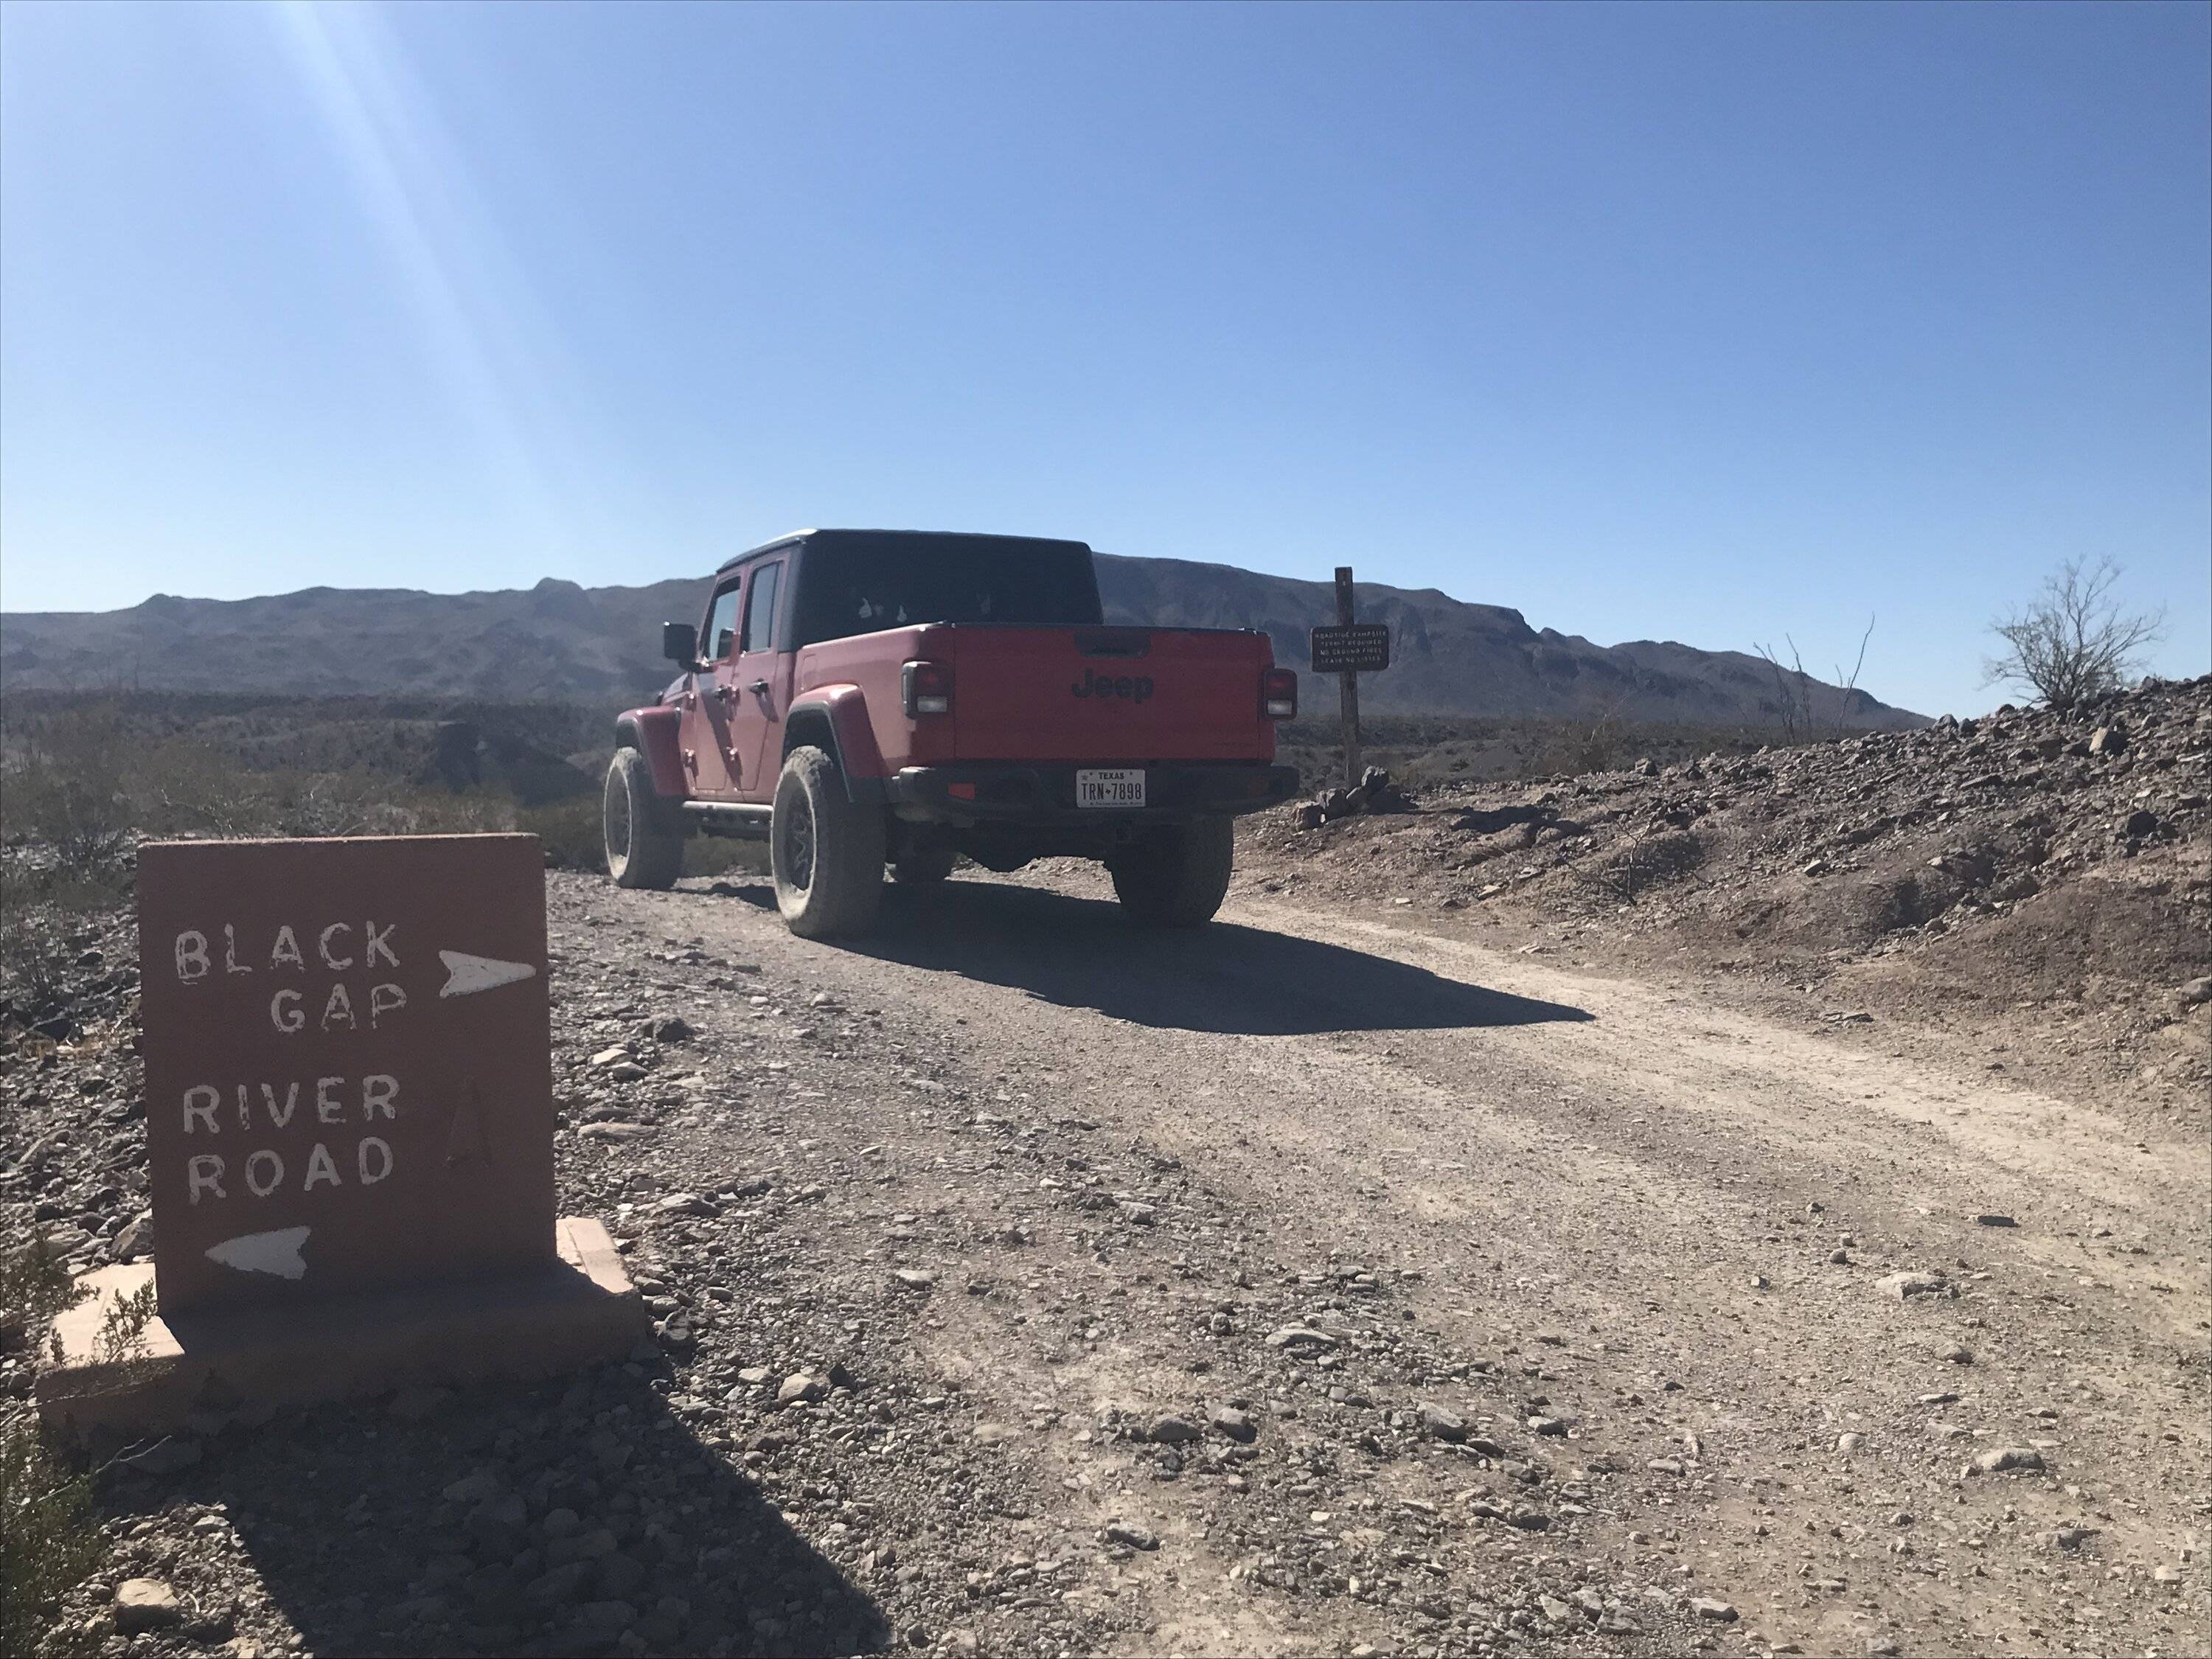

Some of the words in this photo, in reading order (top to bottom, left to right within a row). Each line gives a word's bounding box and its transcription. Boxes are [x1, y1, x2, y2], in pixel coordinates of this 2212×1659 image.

[1071, 667, 1154, 704] Jeep
[174, 920, 400, 984] BLACK
[270, 983, 408, 1033] GAP
[182, 1074, 400, 1134] RIVER
[187, 1136, 394, 1206] ROAD
